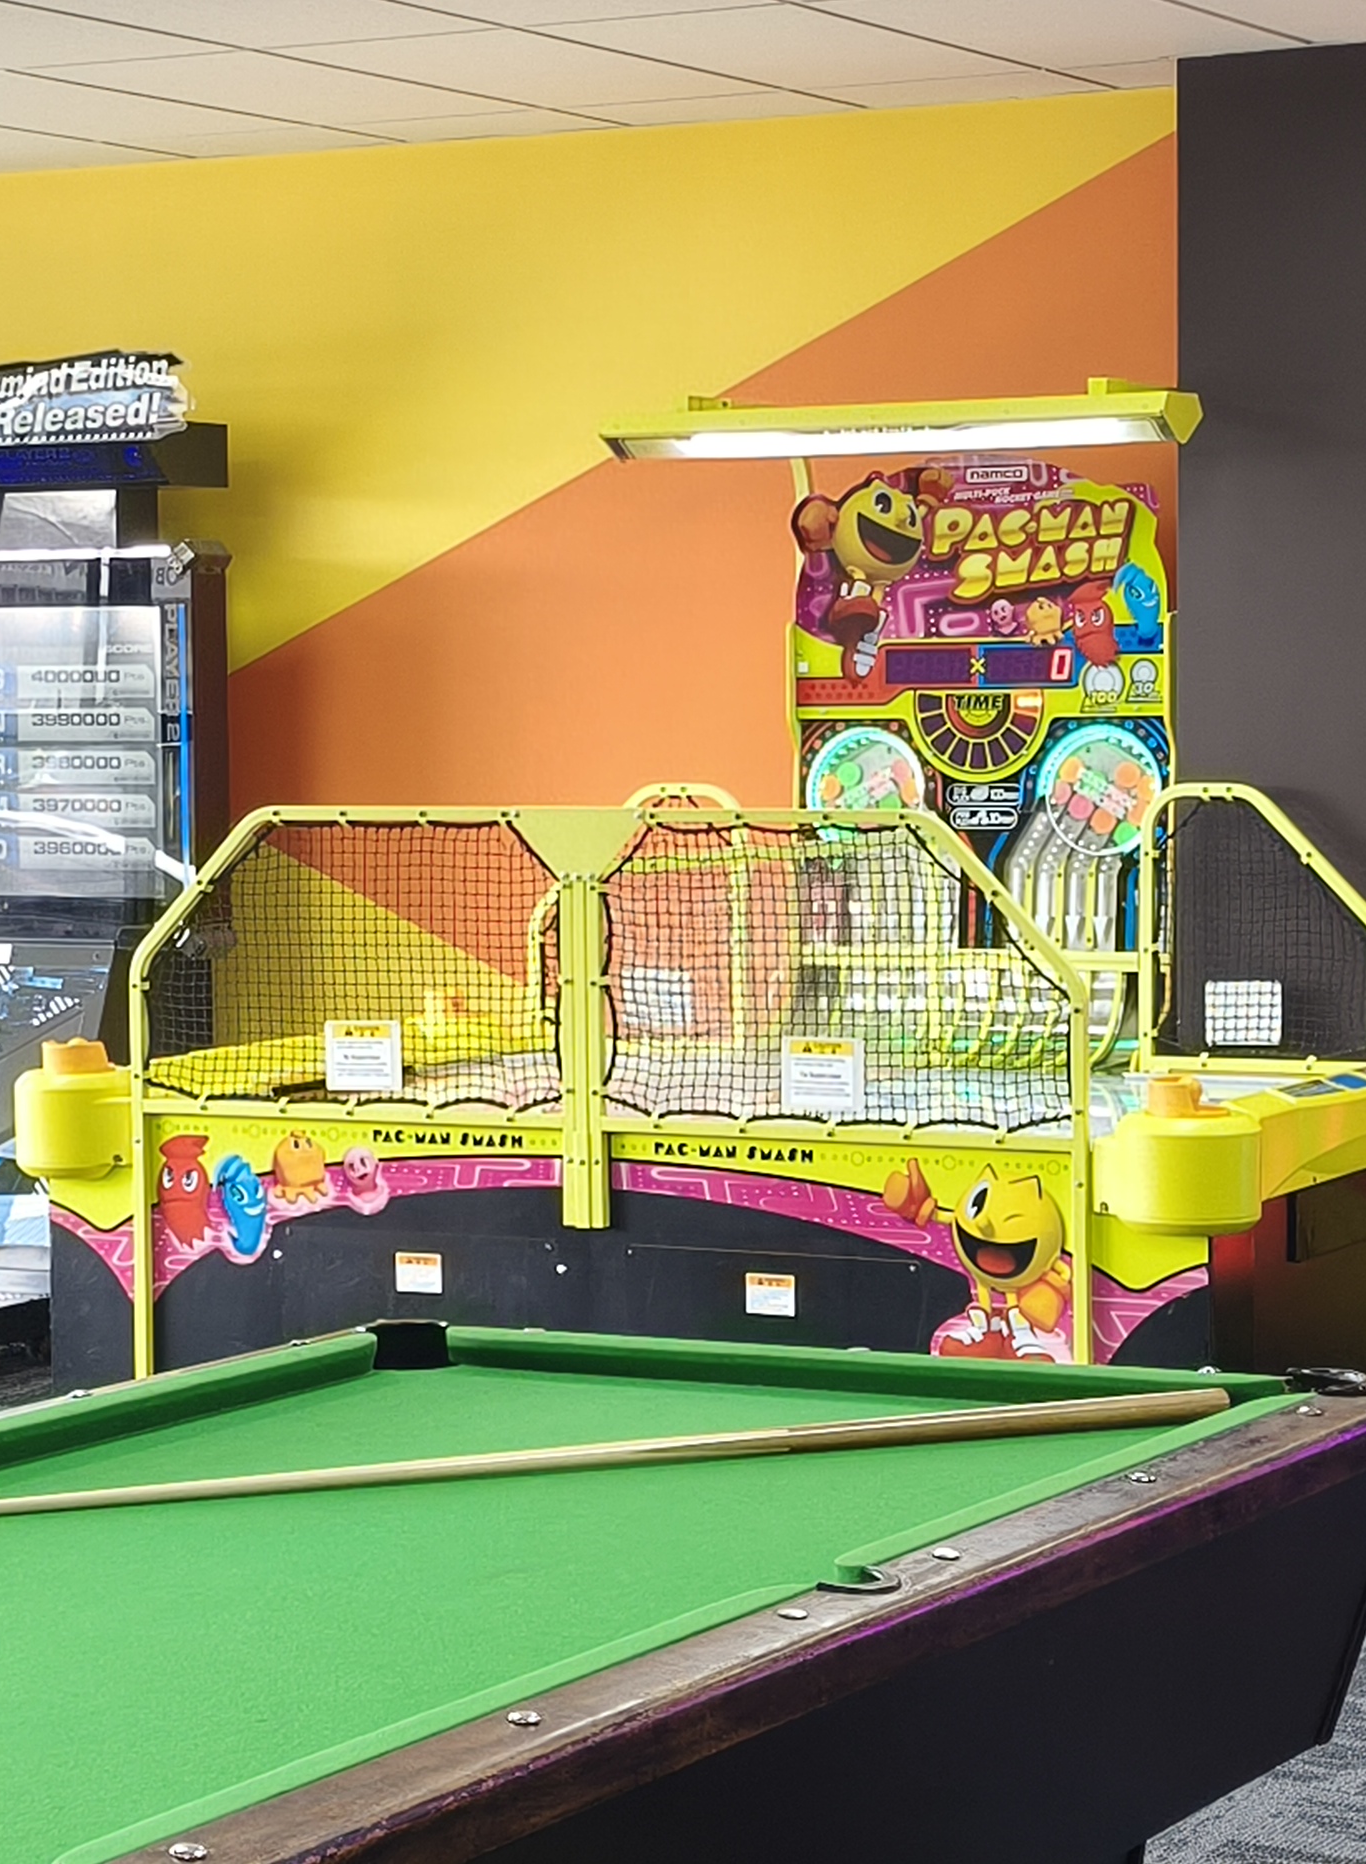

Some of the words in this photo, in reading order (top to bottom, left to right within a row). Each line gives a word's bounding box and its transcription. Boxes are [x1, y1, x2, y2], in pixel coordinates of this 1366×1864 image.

[69, 356, 169, 387] Edition
[970, 469, 1023, 480] namco
[932, 500, 1131, 556] PAC-MAN
[953, 536, 1124, 599] SMASH
[164, 603, 181, 717] PLAYER
[1050, 647, 1073, 681] 0
[31, 670, 120, 683] 4000000
[955, 694, 1004, 709] TIME
[31, 713, 121, 726] 3990000
[166, 723, 181, 741] 2
[32, 798, 122, 812] 3970000
[373, 1129, 451, 1145] PAC-MAN
[460, 1132, 524, 1149] SMASH
[654, 1141, 737, 1159] PAC-MAN
[746, 1145, 814, 1164] SMASH
